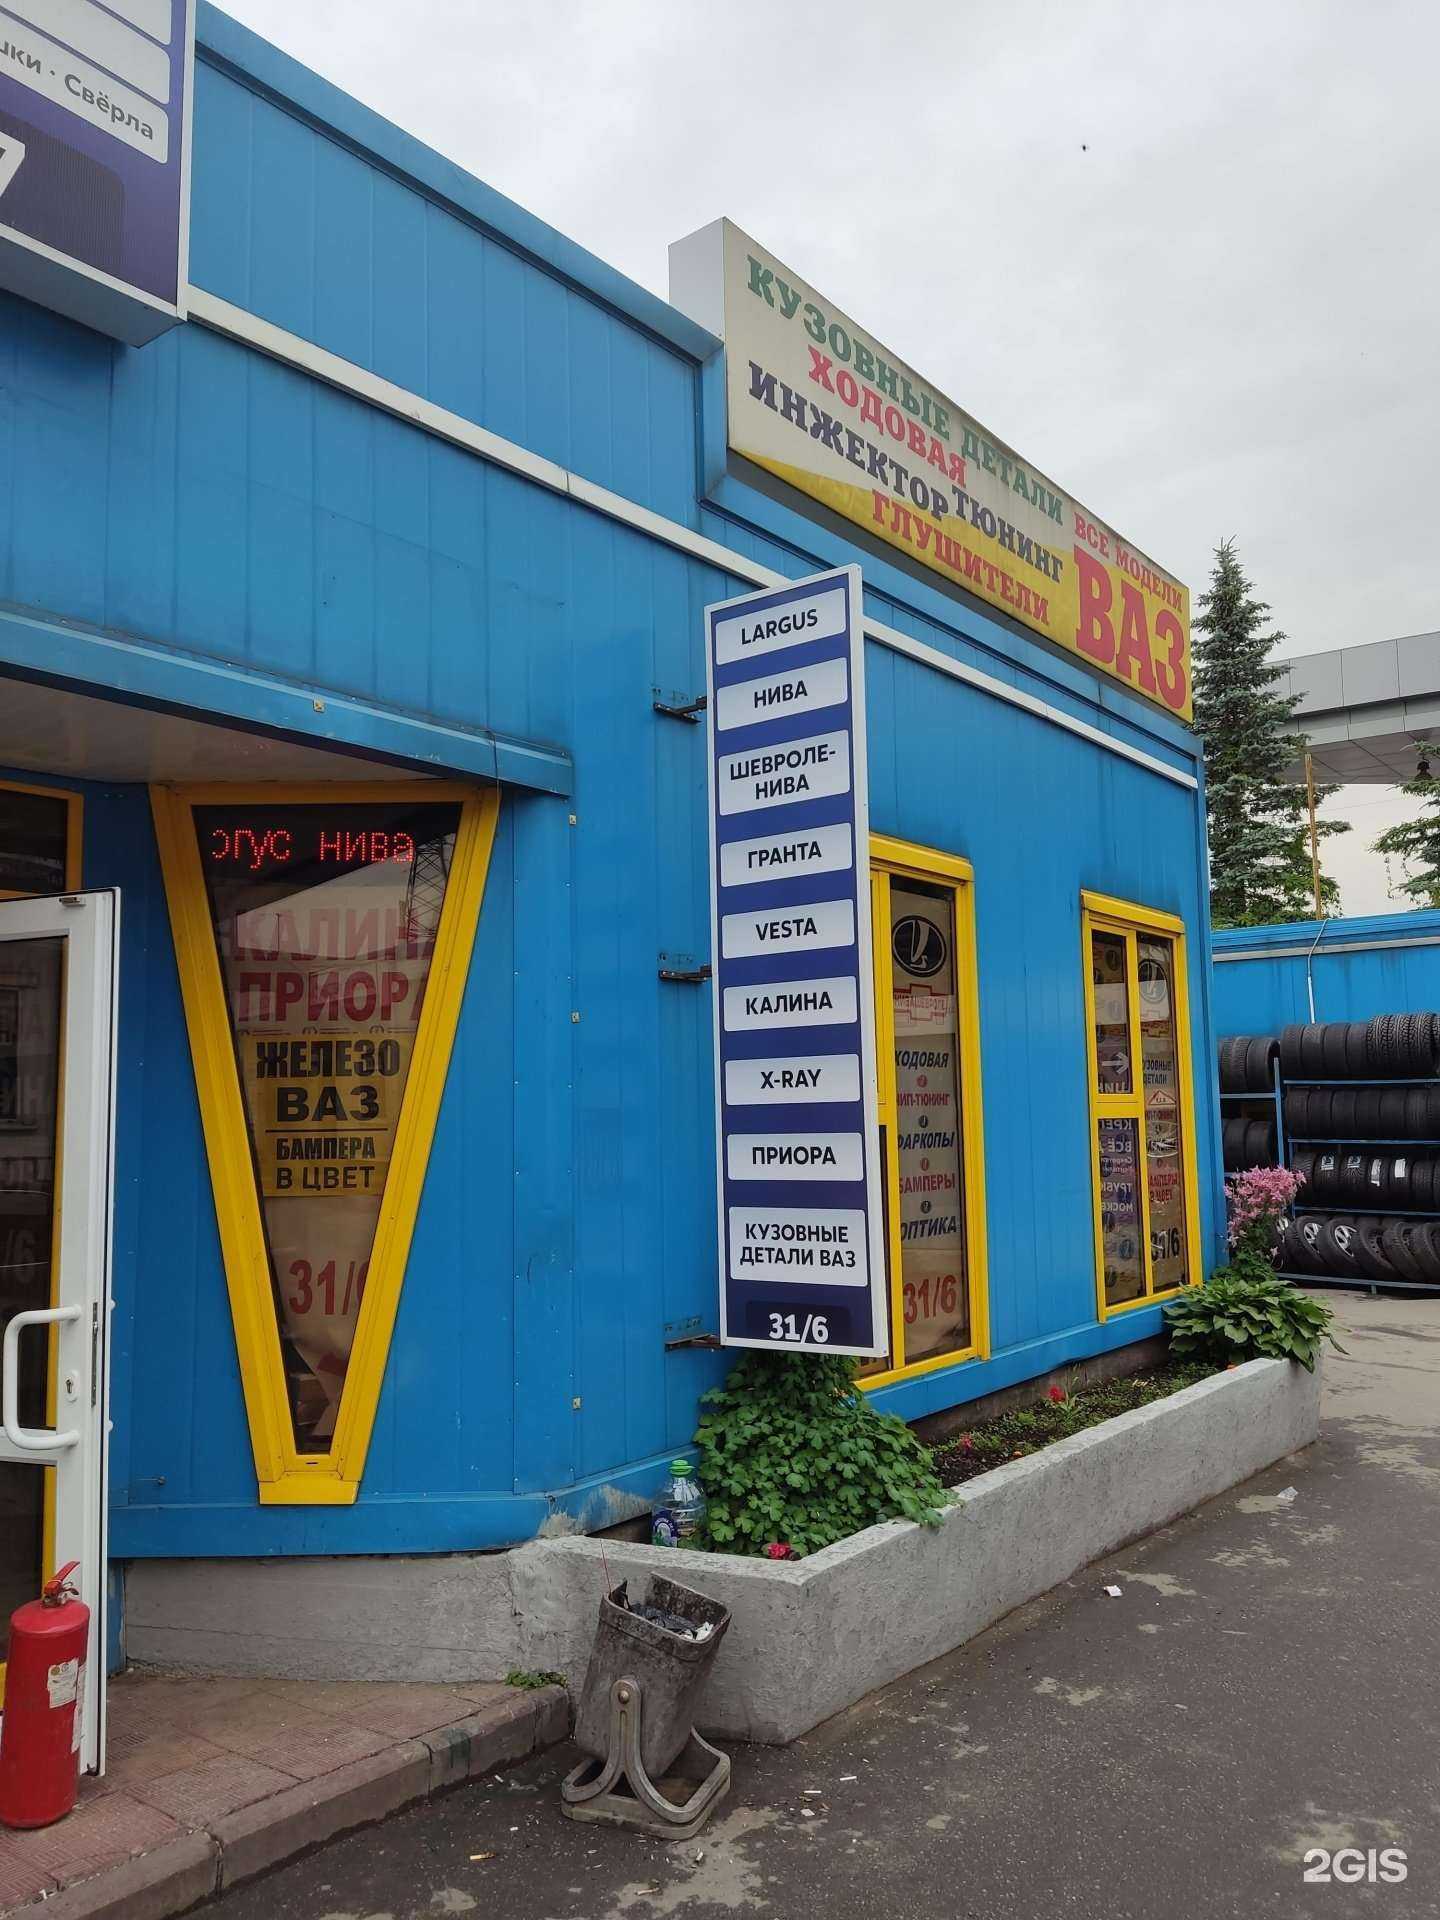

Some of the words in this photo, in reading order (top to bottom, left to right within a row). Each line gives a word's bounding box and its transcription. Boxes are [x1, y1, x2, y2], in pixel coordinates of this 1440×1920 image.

[64, 73, 154, 141] Свёрла
[747, 254, 951, 439] КУЗОВНЫЕ
[961, 425, 1064, 526] ДЕТАЛИ
[808, 344, 967, 488] ХОДОВАЯ
[748, 360, 949, 520] ИНЖЕКТОР
[952, 485, 1064, 584] ТЮНИНГ
[872, 488, 1050, 625] ГЛУШИТЕЛИ
[1074, 511, 1109, 555] ВСЕ
[1116, 538, 1183, 613] МОДЕЛИ
[741, 608, 818, 645] LARGUS
[1073, 543, 1186, 710] ВАЗ
[753, 680, 808, 709] НИВА
[730, 743, 836, 781] ШЕВРОЛЕ-
[755, 774, 809, 800] НИВА
[319, 831, 415, 864] нива
[748, 841, 822, 869] ГРАНТА
[756, 917, 818, 941] VESTA
[746, 991, 833, 1015] КАЛИНА
[256, 1039, 401, 1079] ЖЕЛЕЗО
[761, 1068, 822, 1089] X-RAY
[276, 1086, 380, 1122] ВАЗ
[276, 1136, 376, 1161] БАМПЕРА
[752, 1146, 837, 1166] ПРИОРА
[276, 1167, 293, 1190] В
[302, 1165, 376, 1191] ЦВЕТ
[745, 1223, 849, 1243] КУЗОВНЫЕ
[900, 1215, 957, 1241] ОПТИКА
[739, 1247, 814, 1266] ДЕТАЛИ
[820, 1249, 856, 1268] ВАЗ
[903, 1274, 957, 1324] 31/6
[768, 1312, 829, 1344] 31/6
